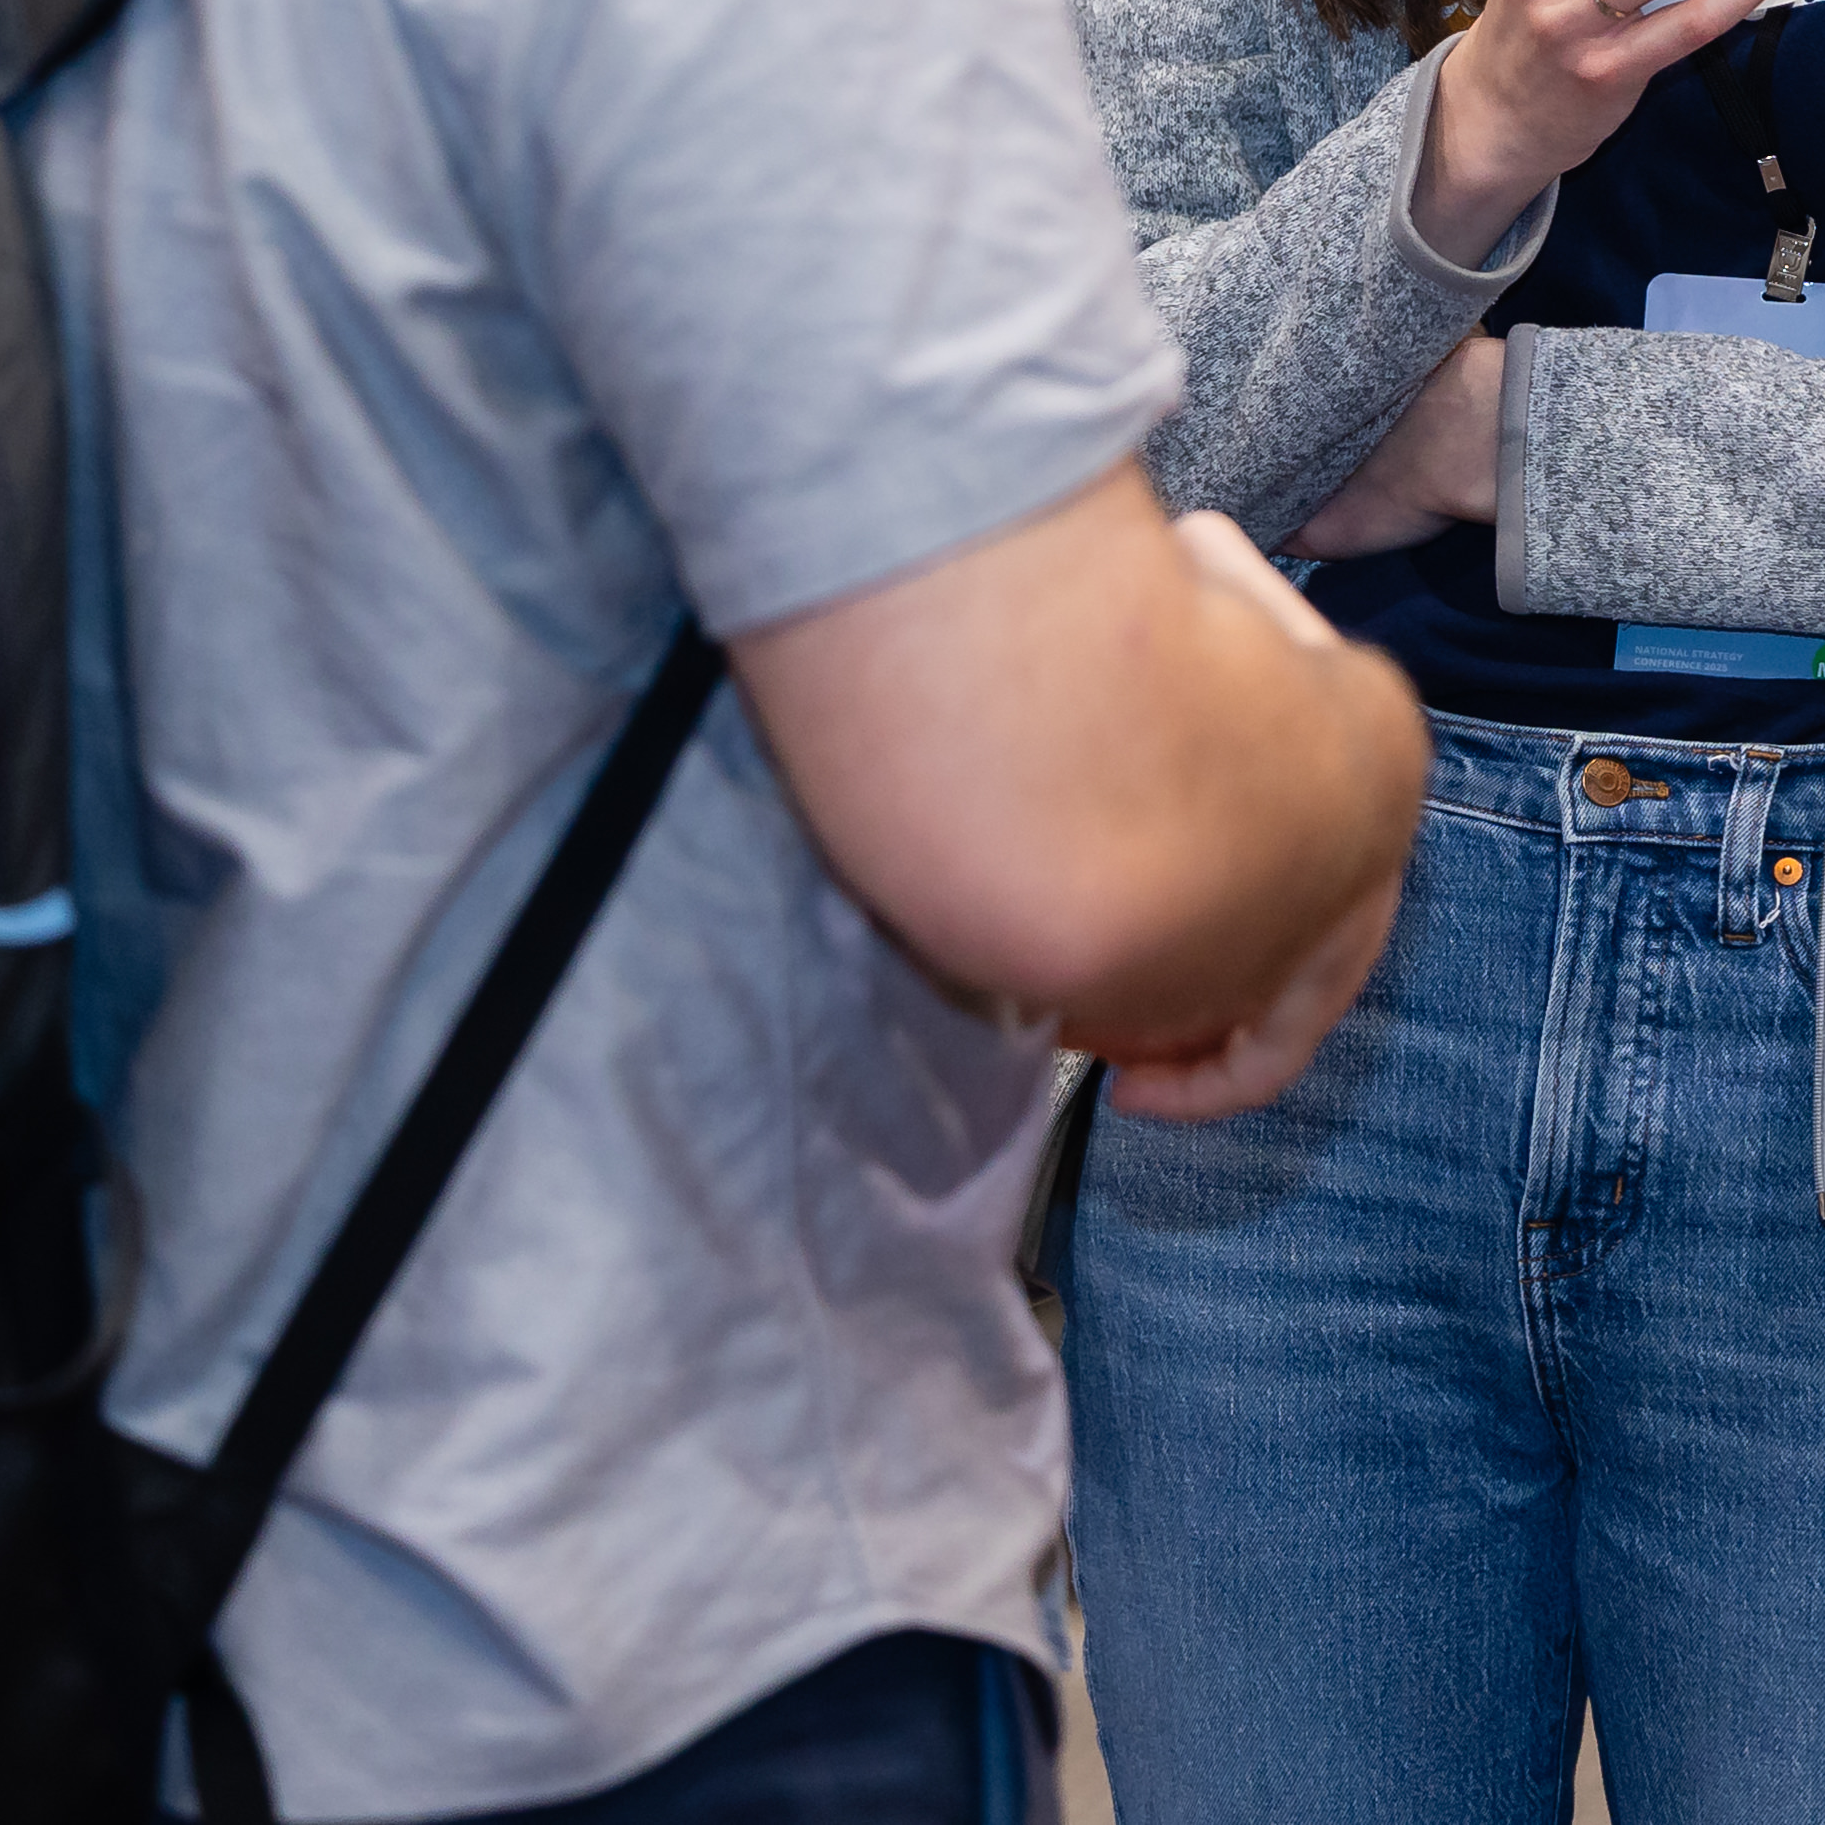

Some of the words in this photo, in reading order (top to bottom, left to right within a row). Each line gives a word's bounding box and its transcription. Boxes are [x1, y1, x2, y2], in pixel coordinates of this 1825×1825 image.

[1634, 645, 1689, 658] NATIONAL
[1691, 649, 1744, 662] STRATEGY
[1633, 657, 1702, 670] CONFERENCE
[1703, 661, 1729, 672] 2025
